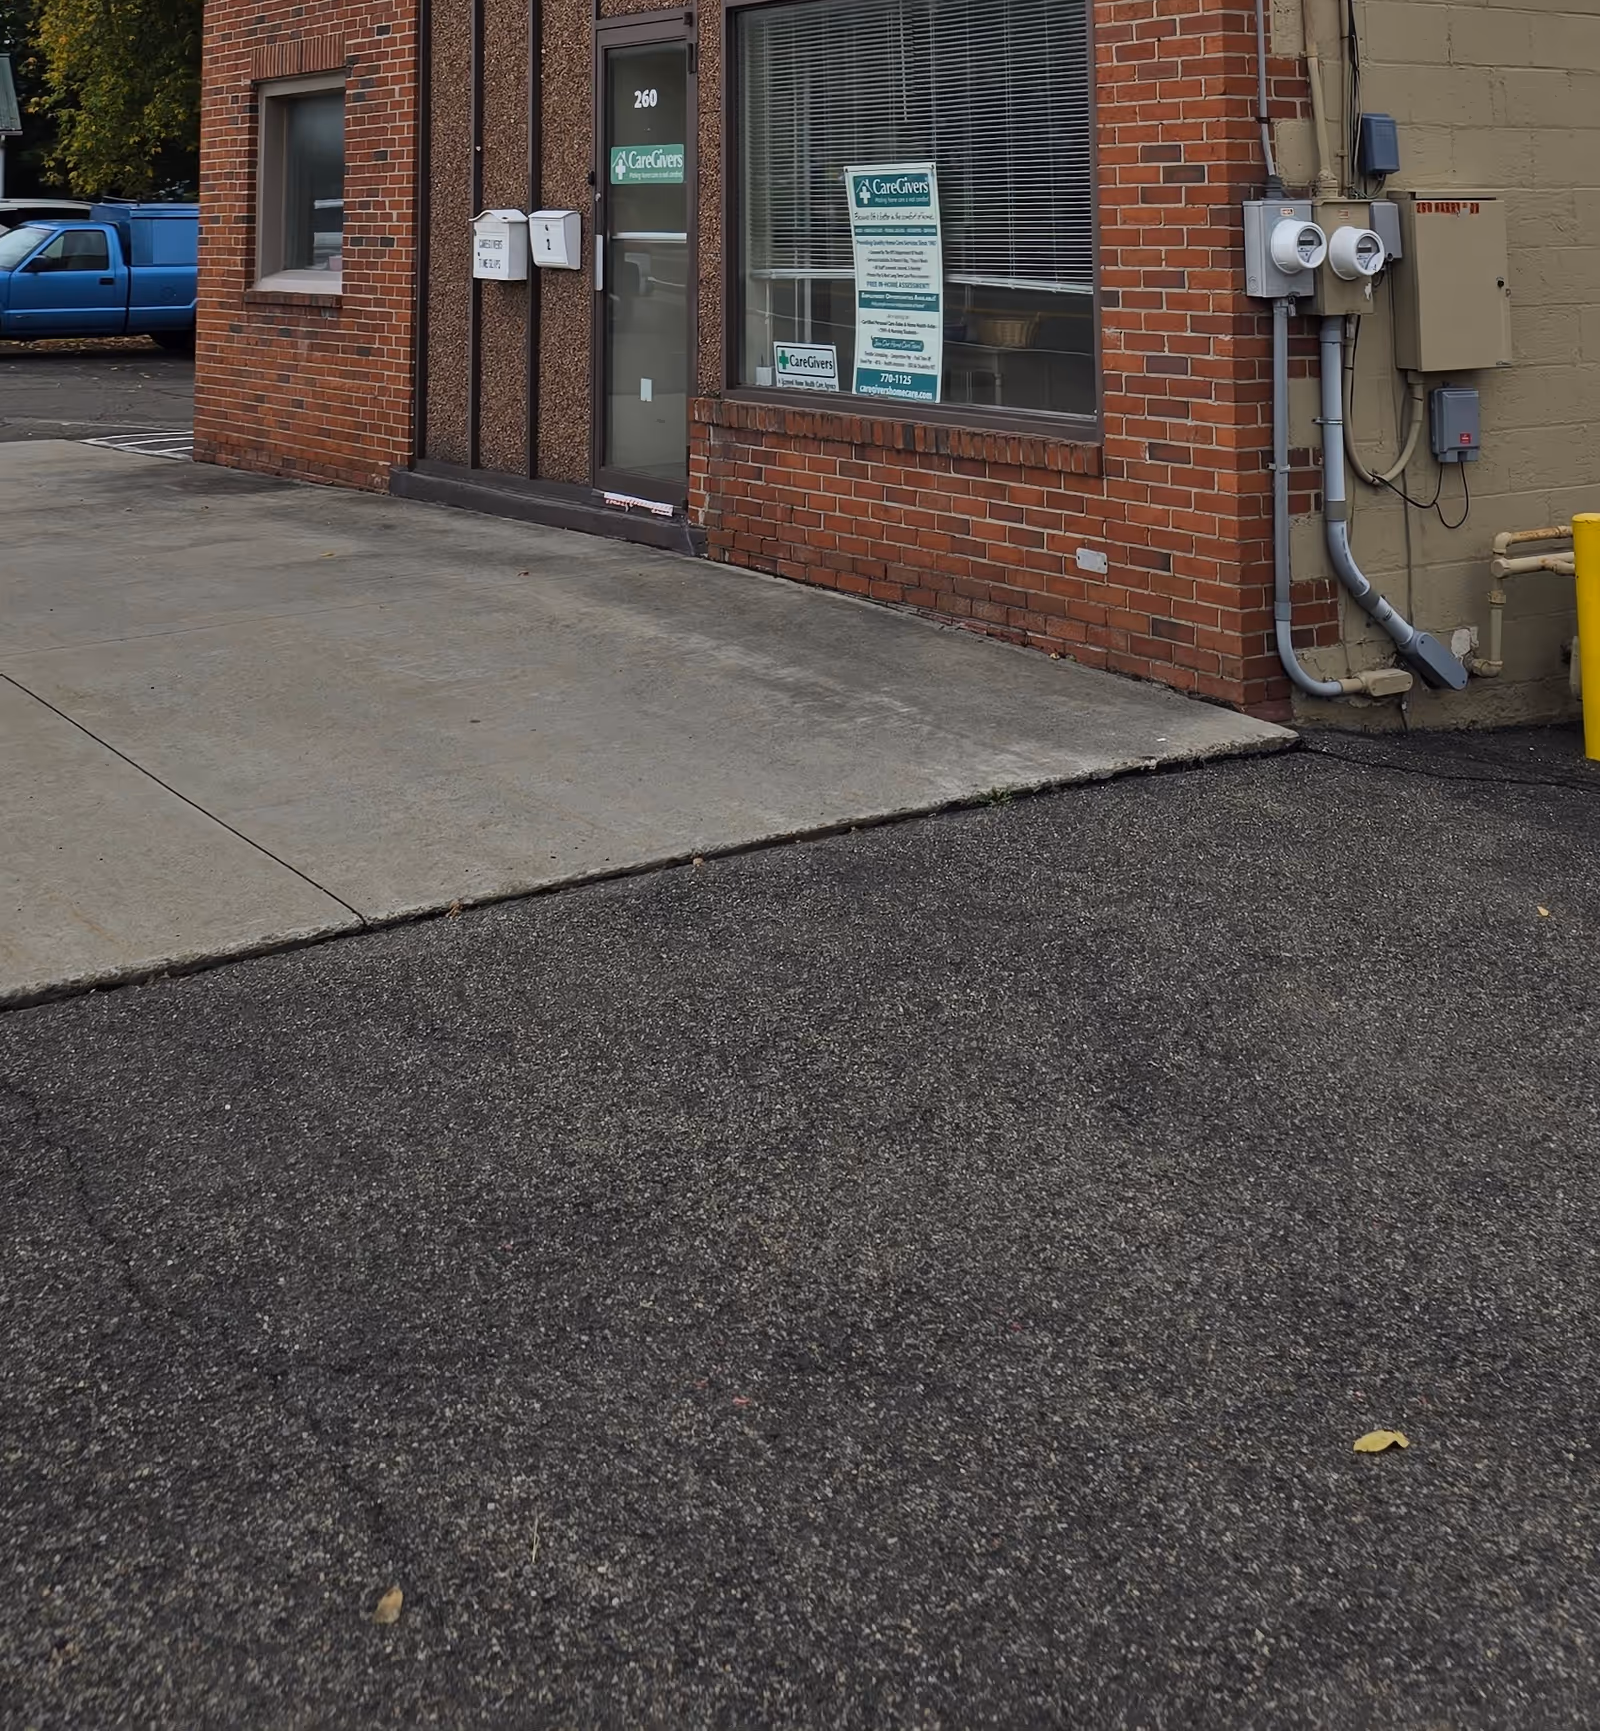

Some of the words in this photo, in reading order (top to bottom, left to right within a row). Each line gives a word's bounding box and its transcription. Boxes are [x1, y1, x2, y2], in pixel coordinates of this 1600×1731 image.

[634, 89, 658, 108] 260
[628, 149, 683, 168] CareGivers
[872, 177, 929, 195] CareGivers
[789, 354, 833, 370] CareGivers
[880, 373, 912, 385] 770-1125
[859, 384, 933, 400] caregivershomecare.com
